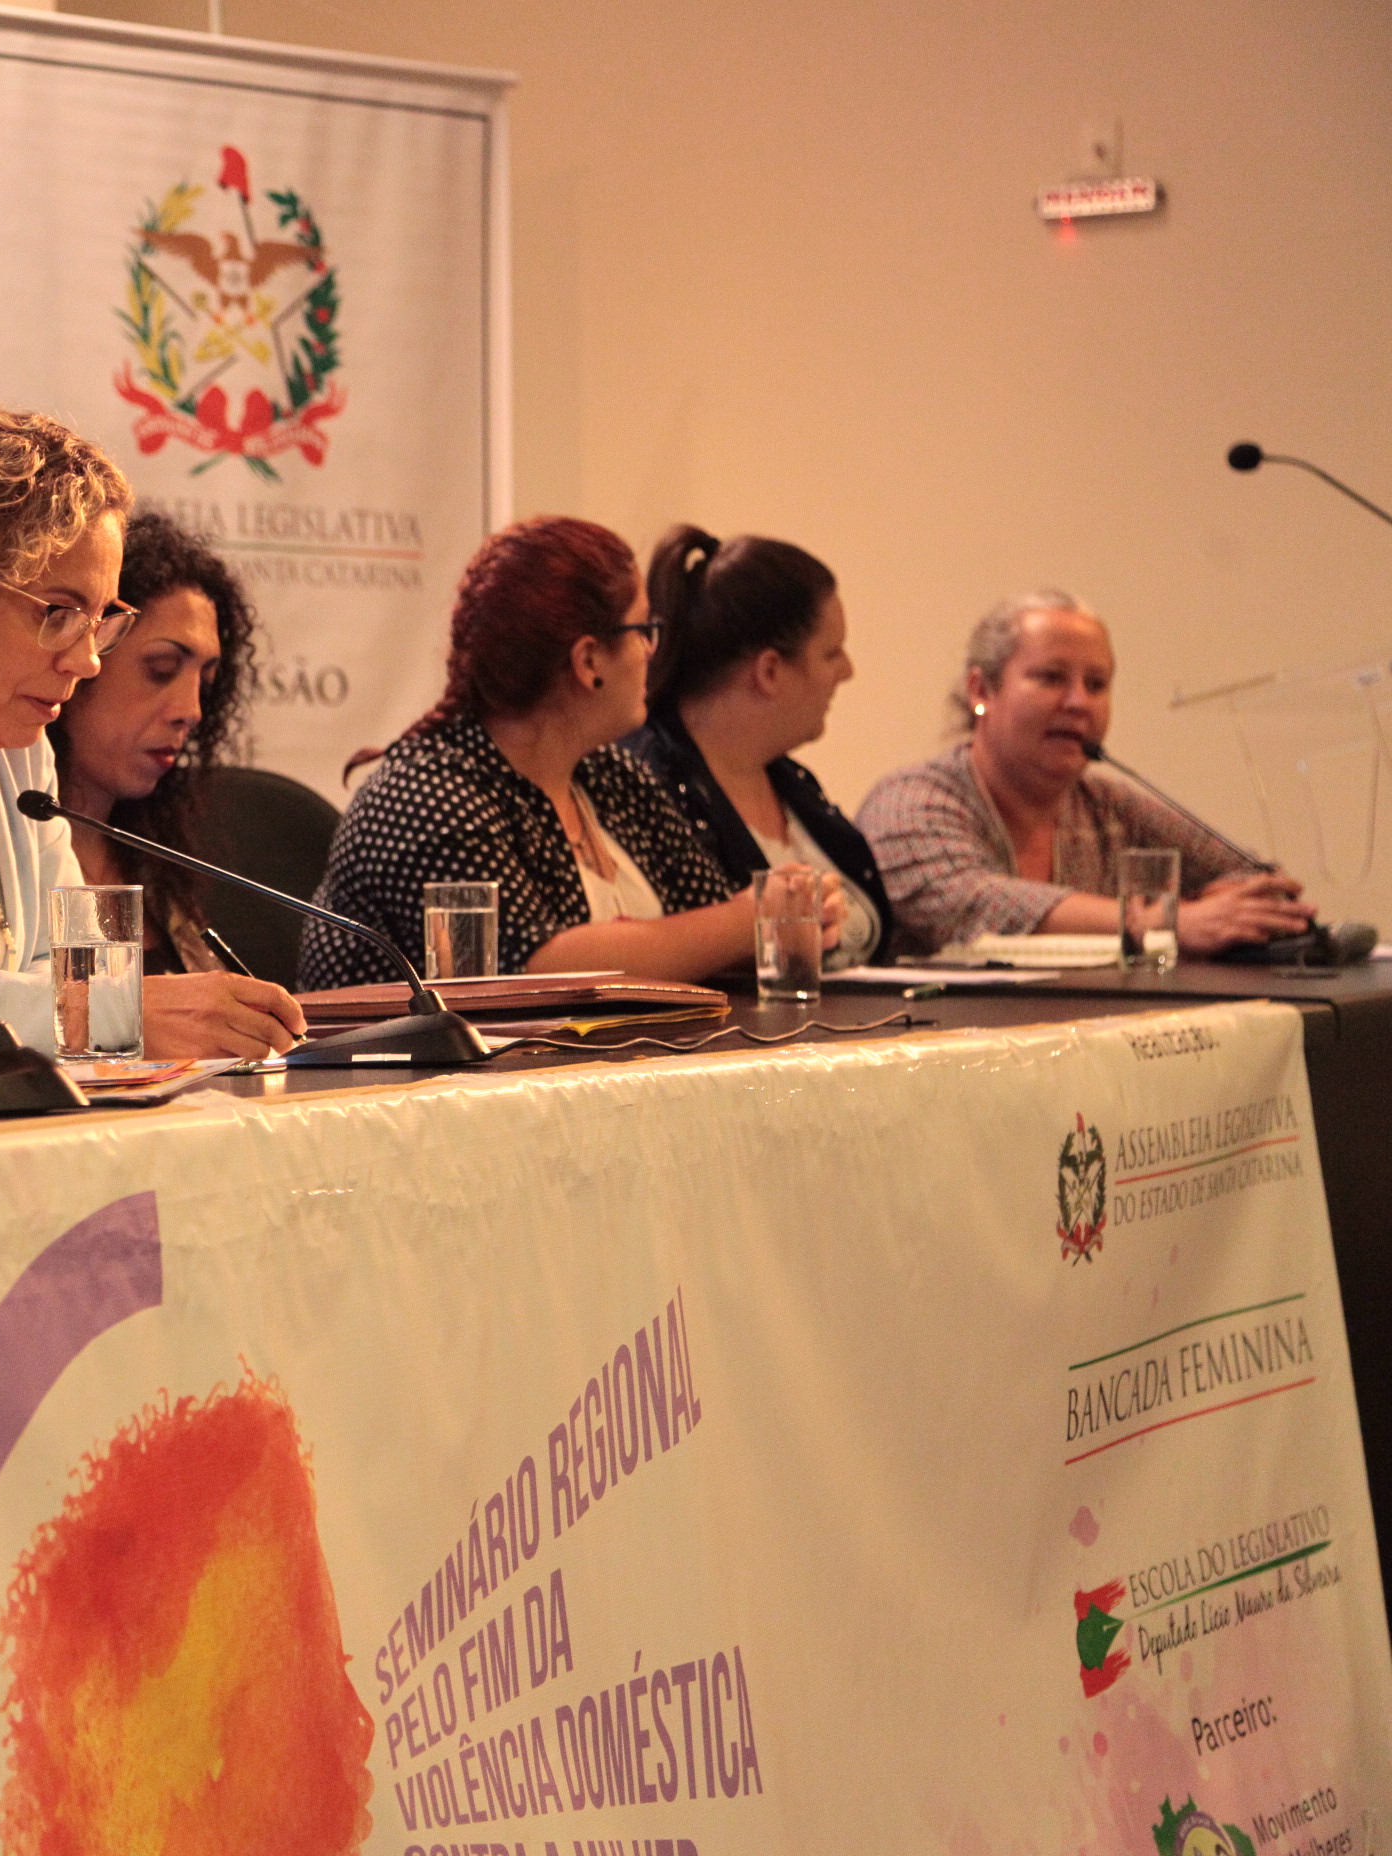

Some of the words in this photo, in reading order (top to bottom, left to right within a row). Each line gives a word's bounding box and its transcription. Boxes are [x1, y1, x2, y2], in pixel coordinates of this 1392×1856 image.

[1115, 1115, 1212, 1172] ASSEMBLEIA
[1113, 1193, 1136, 1227] DO
[1140, 1179, 1188, 1220] ESTADO
[1066, 1356, 1173, 1442] BANCADA
[1178, 1316, 1314, 1398] FEMININA
[375, 1455, 540, 1706] SEMINÁRIO
[548, 1283, 702, 1540] REGIONAL
[1129, 1557, 1195, 1608] ESCOLA
[1198, 1543, 1226, 1583] DO
[1228, 1504, 1331, 1570] LEGISLATIVO
[385, 1662, 457, 1769] PELO
[459, 1605, 520, 1723] FIM
[523, 1568, 574, 1689] DA
[1138, 1605, 1198, 1676] Deputado
[1234, 1589, 1274, 1627] Mauro
[1277, 1567, 1294, 1604] da
[395, 1716, 564, 1831] VIOLÊNCIA
[555, 1645, 764, 1812] DOMÉSTICA
[1191, 1696, 1278, 1756] Parceiro:
[1253, 1786, 1338, 1847] Movimento
